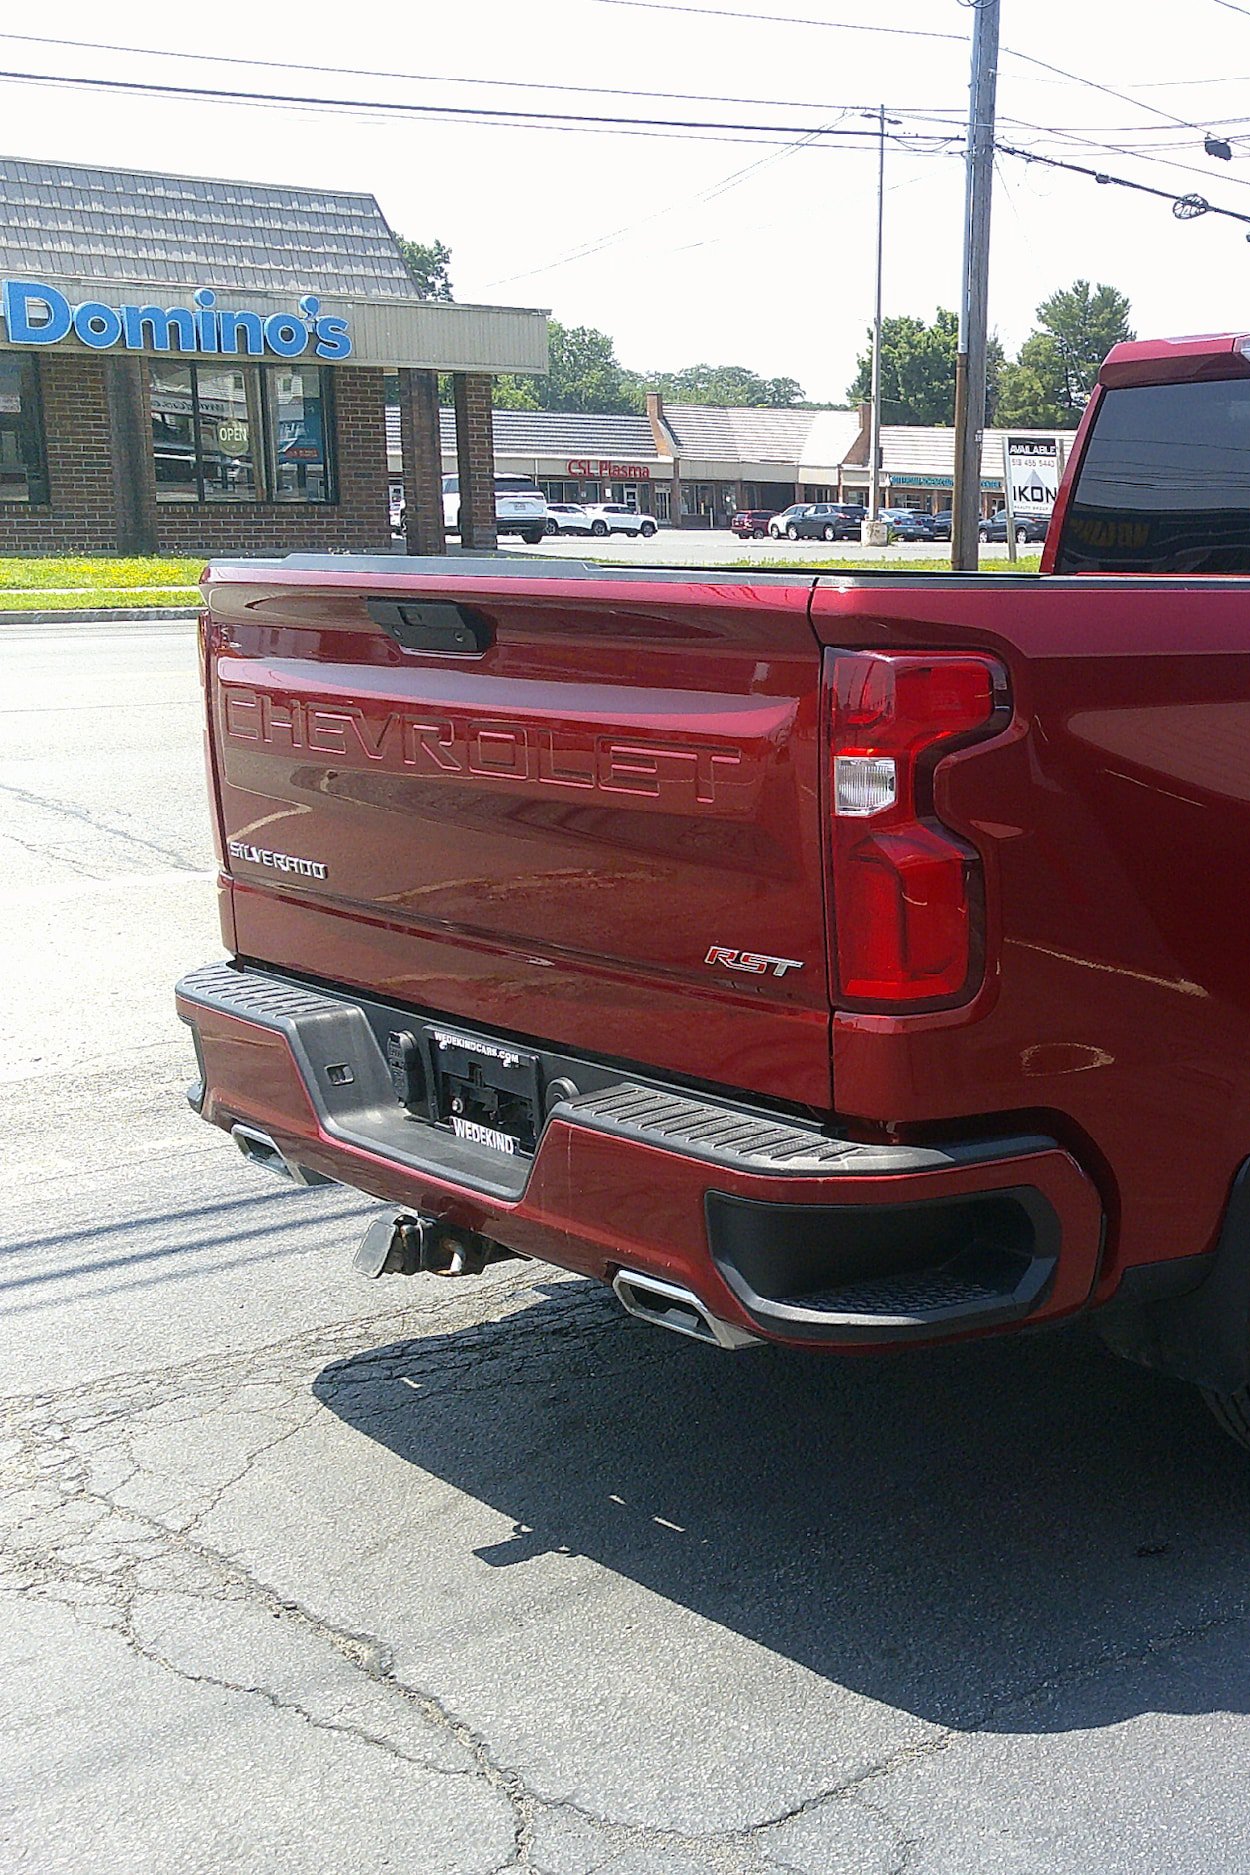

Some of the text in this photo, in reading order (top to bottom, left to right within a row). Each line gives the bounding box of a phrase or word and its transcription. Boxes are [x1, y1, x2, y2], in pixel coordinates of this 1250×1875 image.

[2, 279, 353, 361] Domino's
[219, 427, 248, 442] OPEN
[1009, 444, 1056, 456] AVAILABLE
[567, 460, 651, 479] CSL Plasma
[1013, 485, 1057, 503] IKON
[225, 690, 742, 804] CHEVROLET
[230, 841, 328, 880] SILVERADO
[704, 945, 805, 977] RST
[452, 1117, 515, 1155] WEDEKIND
